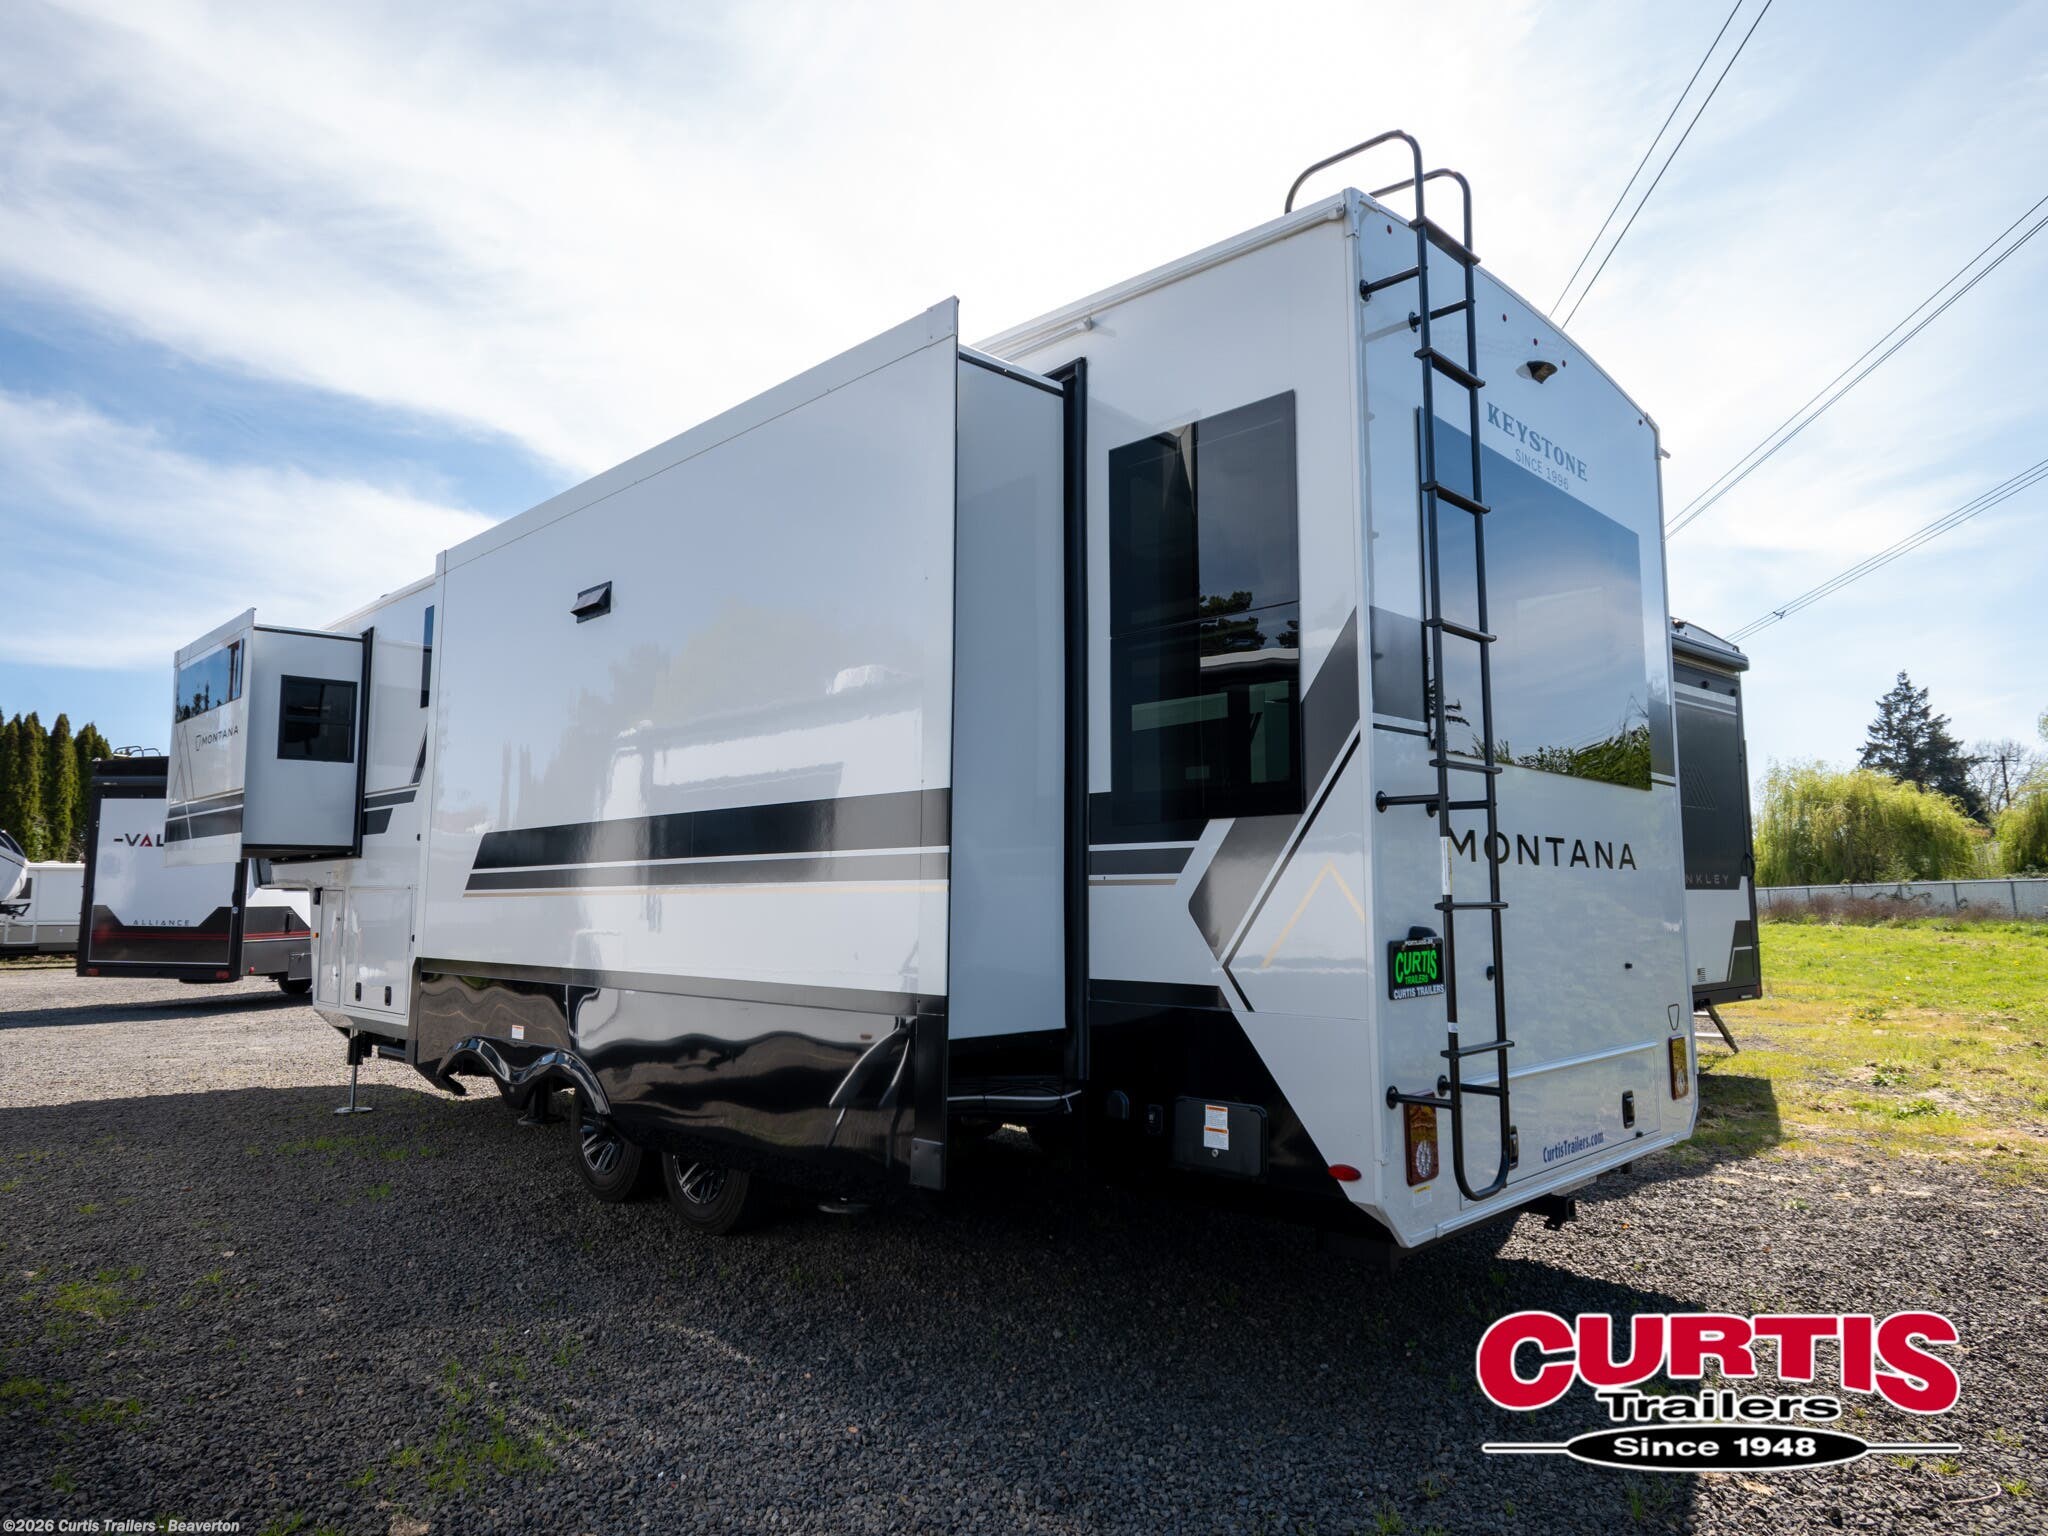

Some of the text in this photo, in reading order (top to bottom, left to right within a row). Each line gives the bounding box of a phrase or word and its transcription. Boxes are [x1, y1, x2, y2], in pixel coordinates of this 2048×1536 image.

[1487, 401, 1588, 482] KEYSTONE
[1515, 448, 1569, 491] SINCE 1996
[201, 724, 239, 746] MONTANA
[1449, 826, 1637, 871] MONTANA
[133, 919, 190, 927] ALLIANCE
[1395, 950, 1437, 983] CURTIS
[1405, 974, 1429, 984] TRAILERS
[1394, 984, 1445, 999] CURTIS TRAILERS
[1543, 1132, 1604, 1163] CurtisTrailers.com
